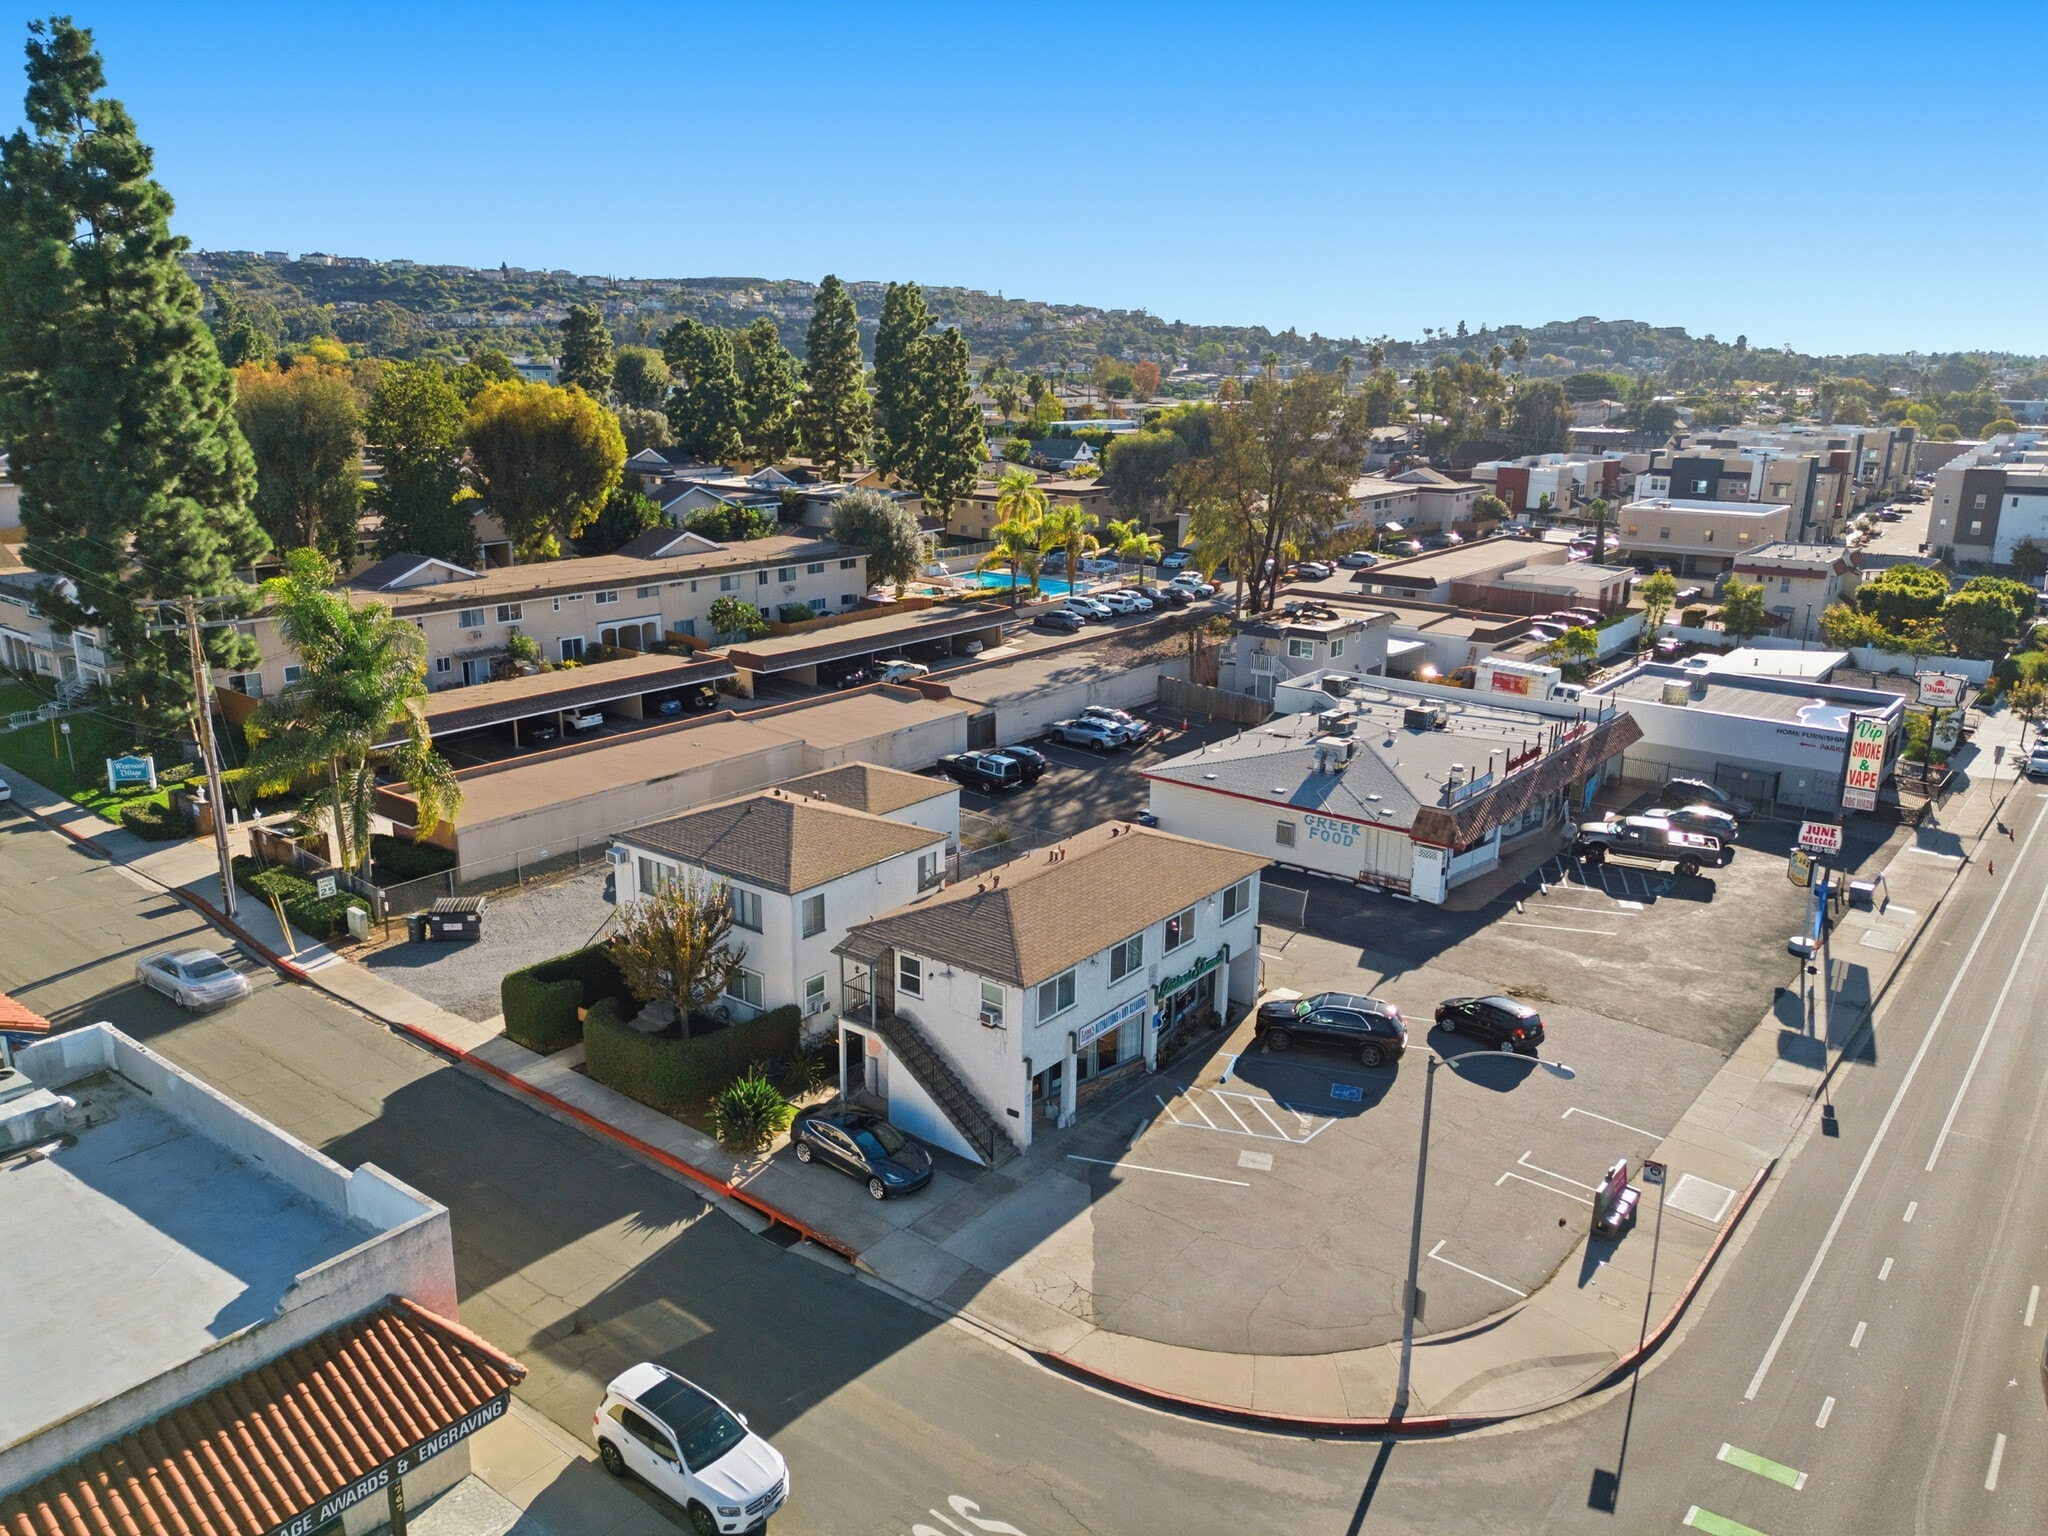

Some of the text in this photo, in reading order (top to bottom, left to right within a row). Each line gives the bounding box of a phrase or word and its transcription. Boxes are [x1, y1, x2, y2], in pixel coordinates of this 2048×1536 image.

[1776, 728, 1847, 744] HOME FURNISHIN
[1856, 723, 1883, 741] Vip
[1819, 744, 1846, 753] PARKI
[1852, 741, 1882, 760] SMOKE
[1859, 759, 1870, 771] &
[1849, 769, 1878, 789] VAPE
[1304, 814, 1361, 836] GREEK
[1805, 824, 1838, 839] JUNE
[1309, 826, 1354, 847] FOOD
[1801, 835, 1838, 847] MASSAGE
[320, 886, 335, 897] 25
[320, 1470, 389, 1522] AWARDS
[397, 1458, 410, 1475] &
[418, 1400, 503, 1462] ENGRAVING
